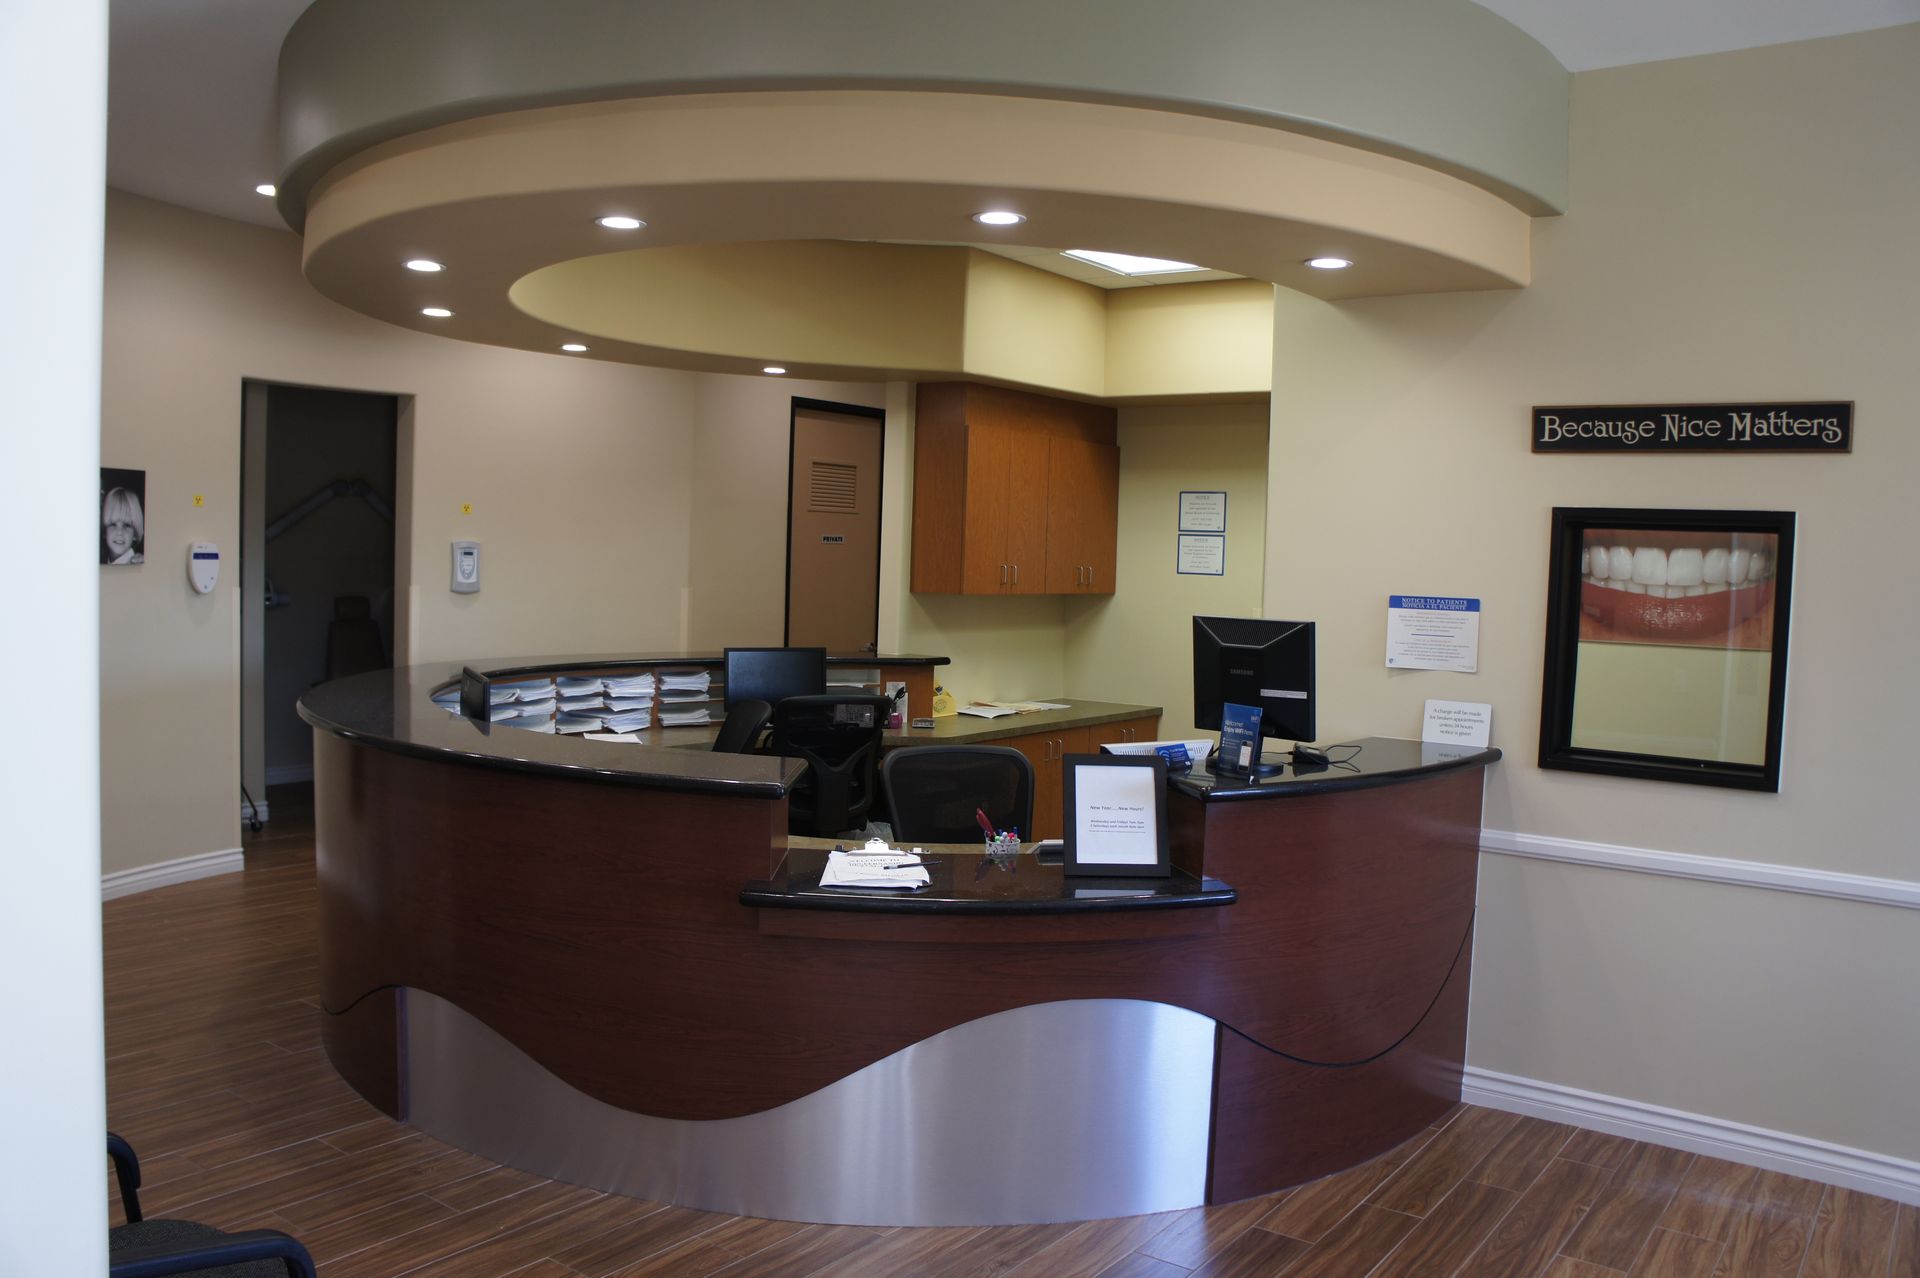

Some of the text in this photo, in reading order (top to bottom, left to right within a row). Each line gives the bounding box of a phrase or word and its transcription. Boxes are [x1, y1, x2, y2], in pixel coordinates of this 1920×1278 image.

[1539, 410, 1842, 445] Because Nice Matters
